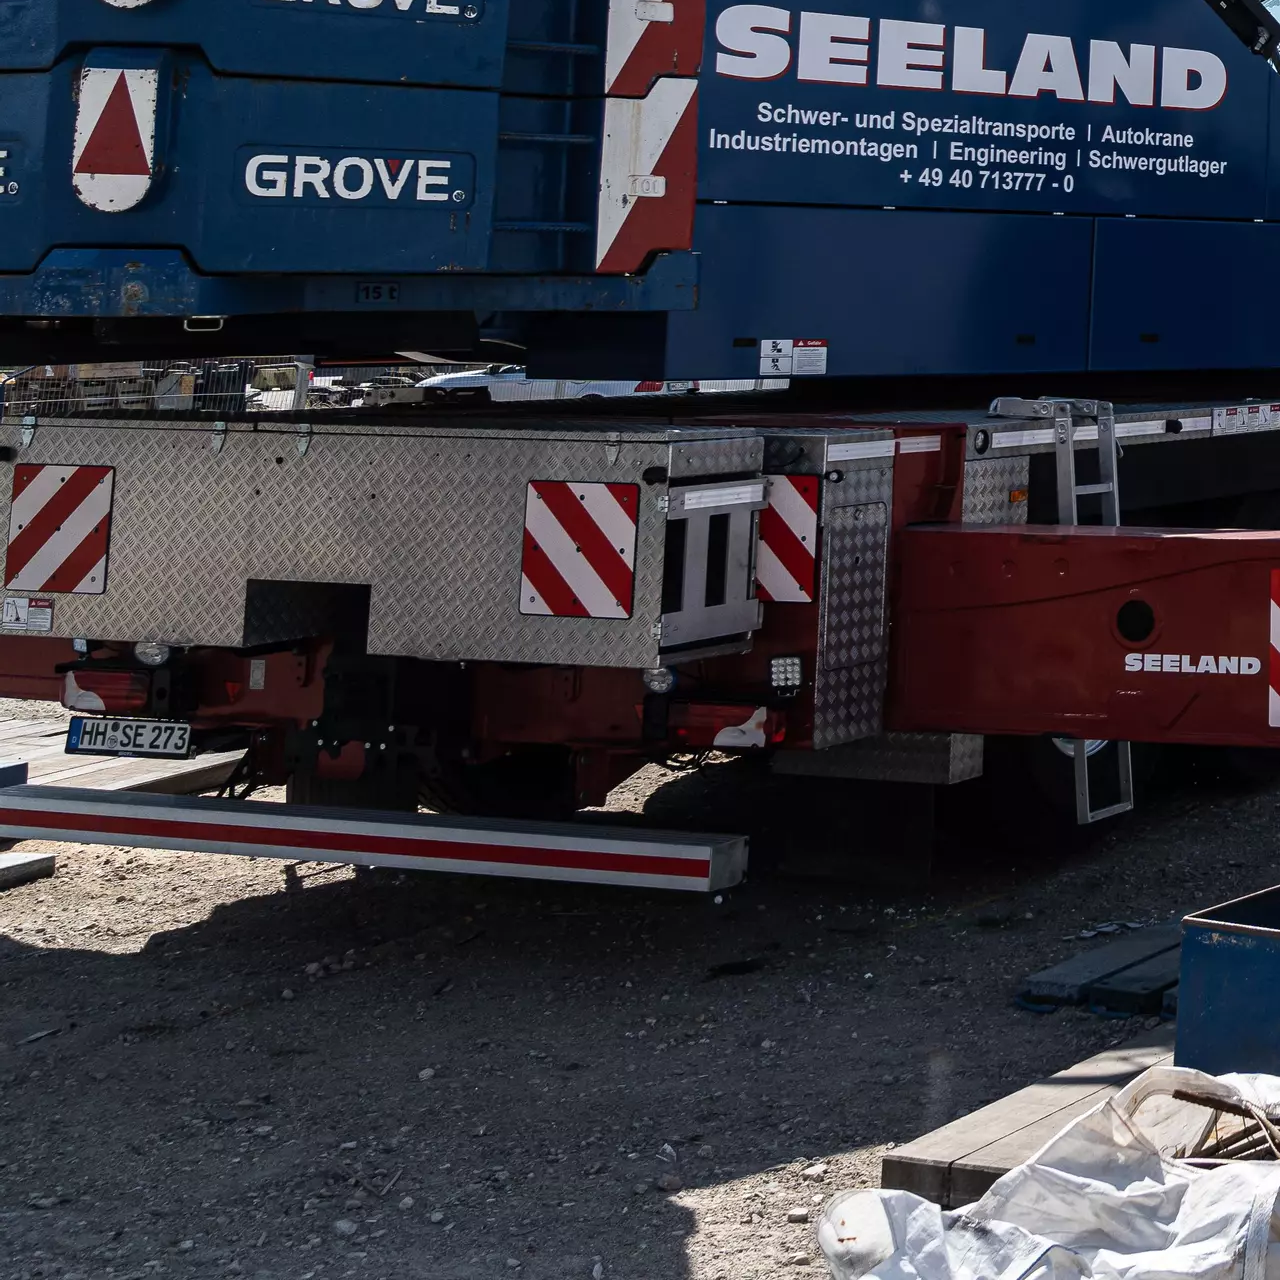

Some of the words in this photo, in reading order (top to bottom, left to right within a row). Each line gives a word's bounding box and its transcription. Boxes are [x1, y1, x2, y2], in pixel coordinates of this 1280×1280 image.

[715, 4, 1228, 110] SEELAND
[757, 102, 849, 126] Schwer-
[855, 110, 895, 130] und
[901, 111, 1076, 143] Spezialtransporte
[1101, 125, 1194, 148] Autokrane
[709, 128, 918, 162] Industriemontagen
[950, 141, 1067, 171] Engineering
[1088, 149, 1228, 178] Schwergutlager
[245, 154, 451, 201] GROVE
[918, 167, 943, 187] 49
[949, 168, 973, 188] 40
[979, 170, 1046, 191] 713777
[1063, 174, 1074, 193] 0
[361, 285, 383, 300] 15
[1124, 652, 1261, 675] SEELAND
[79, 721, 109, 747] HH
[120, 724, 147, 749] SE
[148, 725, 189, 751] 273
